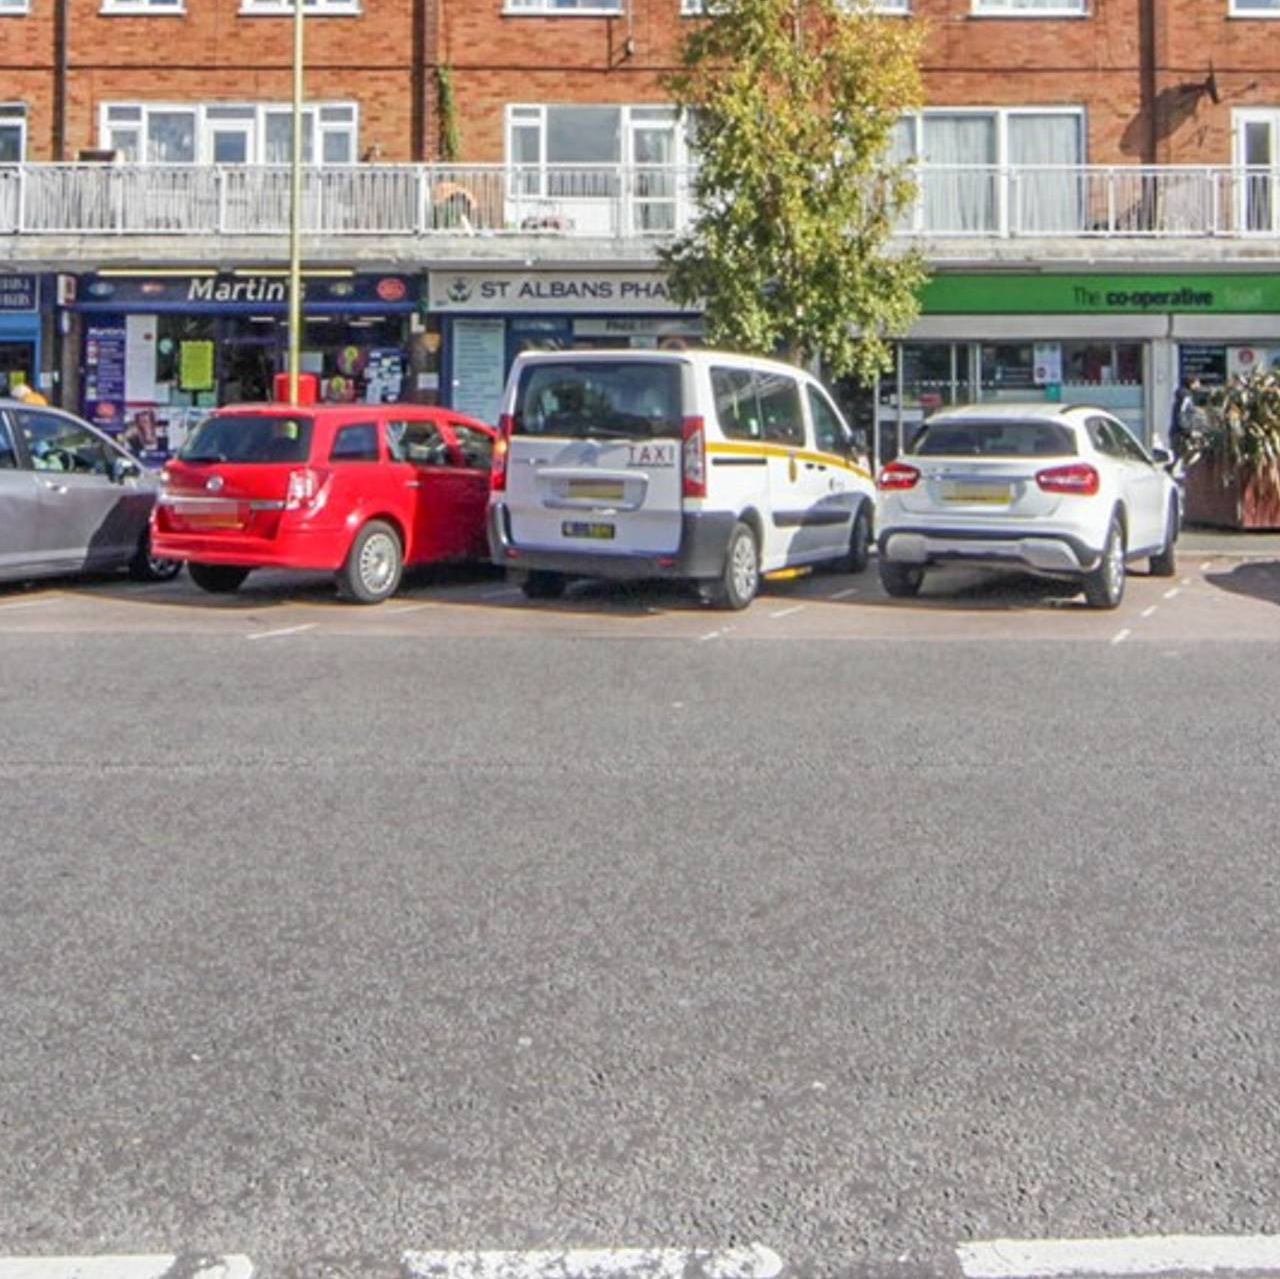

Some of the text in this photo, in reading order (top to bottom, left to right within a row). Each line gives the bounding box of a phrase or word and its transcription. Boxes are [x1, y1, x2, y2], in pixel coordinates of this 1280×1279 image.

[480, 280, 511, 299] ST
[520, 280, 614, 299] ALBANS
[1106, 286, 1214, 309] co-operative
[627, 446, 675, 462] TAXI
